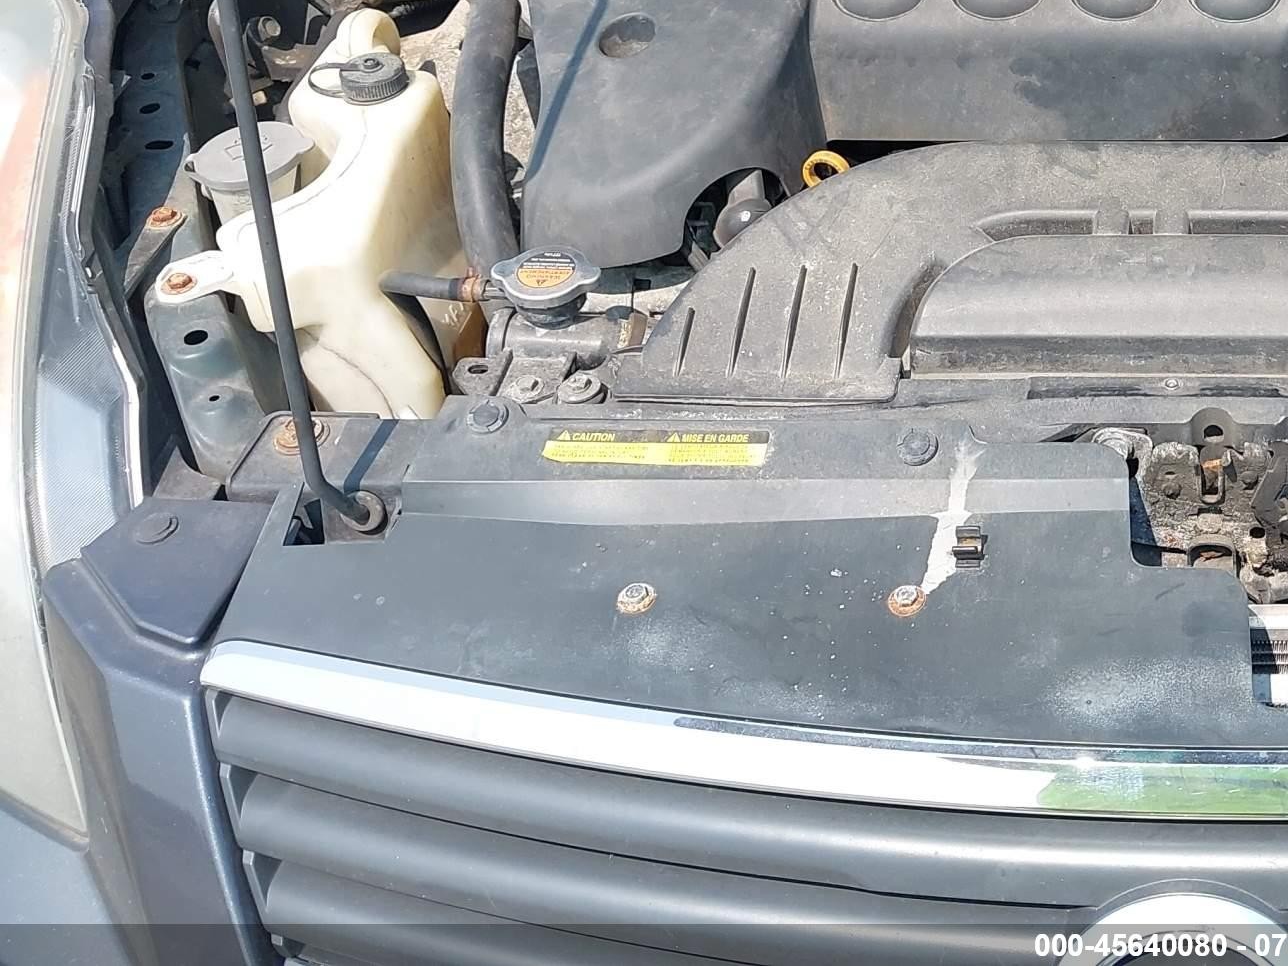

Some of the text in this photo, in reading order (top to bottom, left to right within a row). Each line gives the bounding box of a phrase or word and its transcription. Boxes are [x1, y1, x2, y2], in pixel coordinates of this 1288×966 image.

[572, 432, 616, 442] CAUTION
[681, 433, 750, 443] MISE EN GARDE
